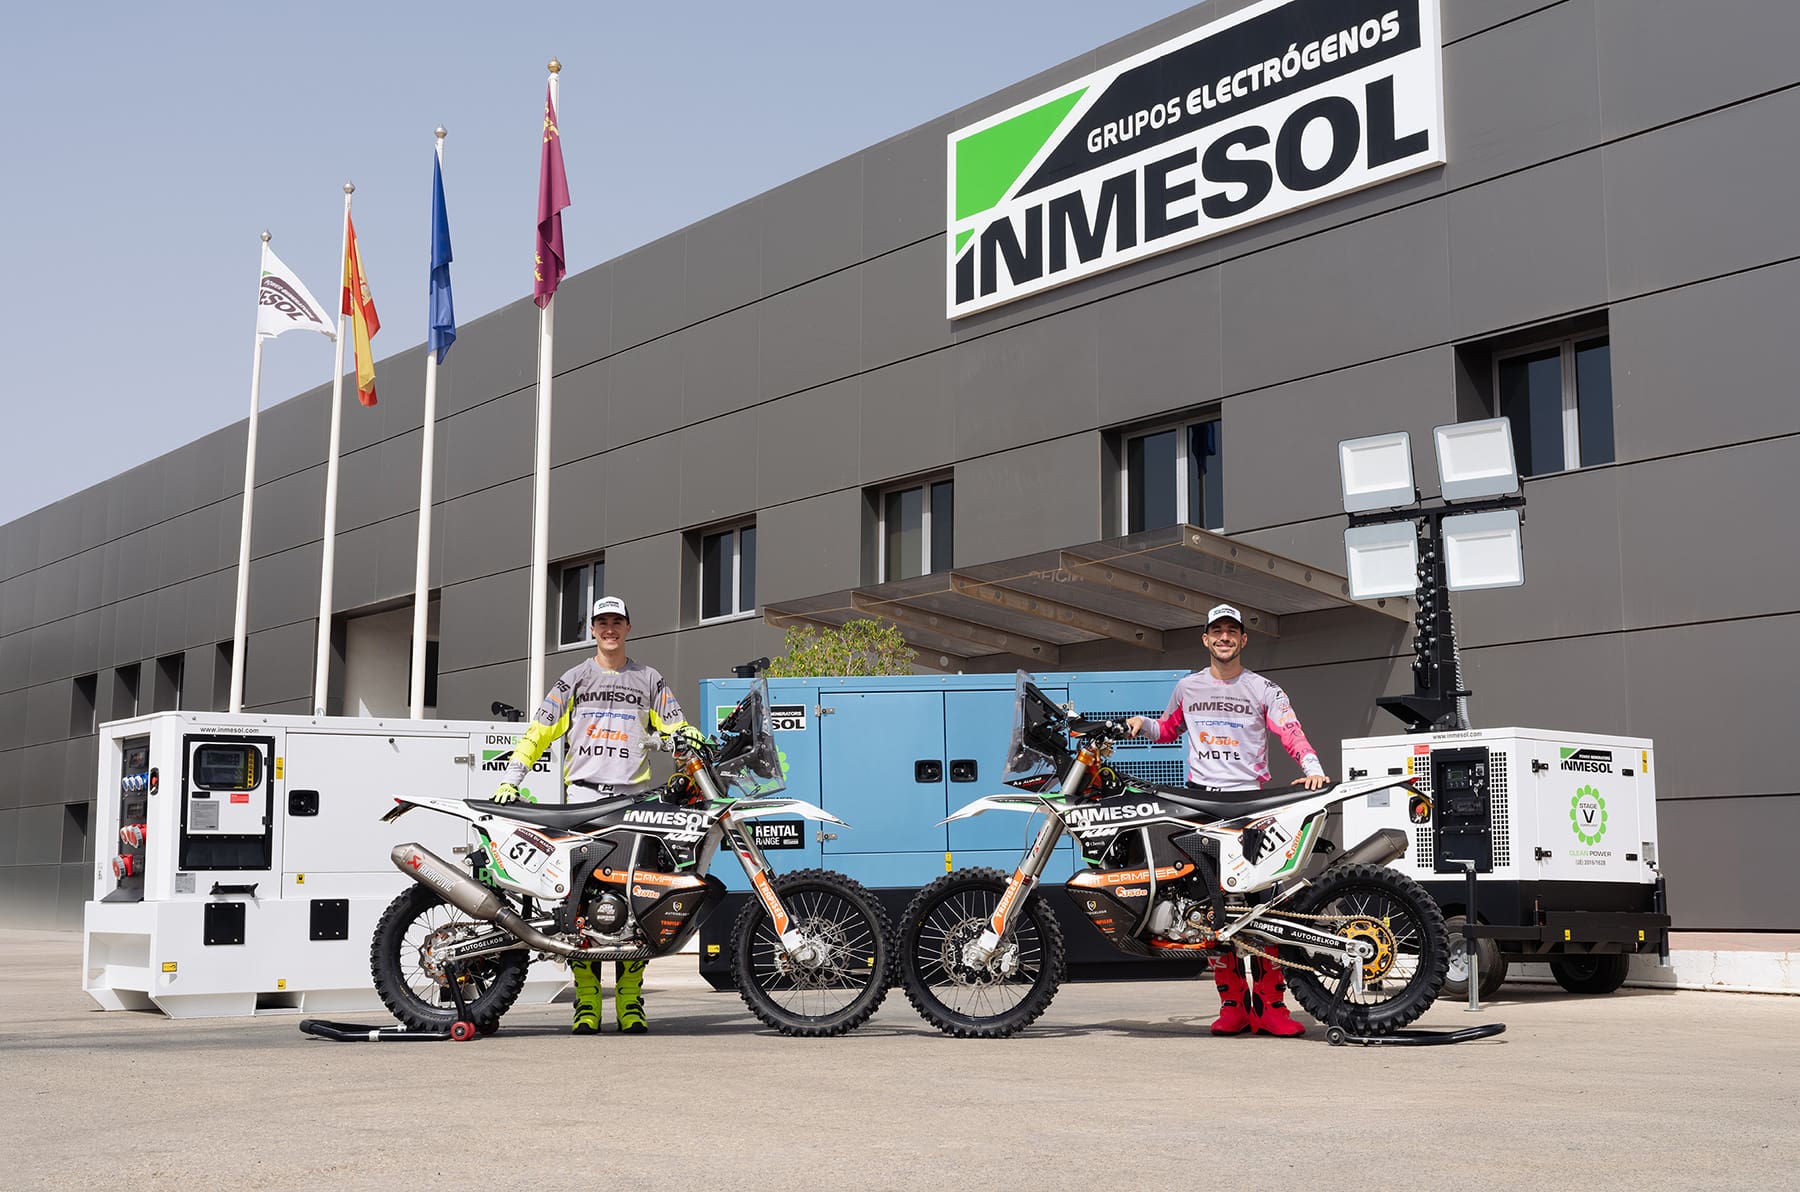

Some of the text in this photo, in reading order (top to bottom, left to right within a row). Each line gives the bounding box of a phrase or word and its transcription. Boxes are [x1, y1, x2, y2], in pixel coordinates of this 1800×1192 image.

[1087, 10, 1400, 154] GRUPOS ELECTRÓGENOS
[1433, 731, 1482, 740] www.inmesol.com
[579, 745, 630, 758] MOTS
[1582, 809, 1595, 824] V
[755, 825, 798, 837] RENTAL
[760, 881, 784, 919] TRAPISER
[995, 880, 1019, 919] TRAPISER
[1249, 920, 1284, 935] TRAPISER
[460, 937, 504, 953] AUTOGELKOR
[1290, 931, 1340, 947] AUTOGELKOR
